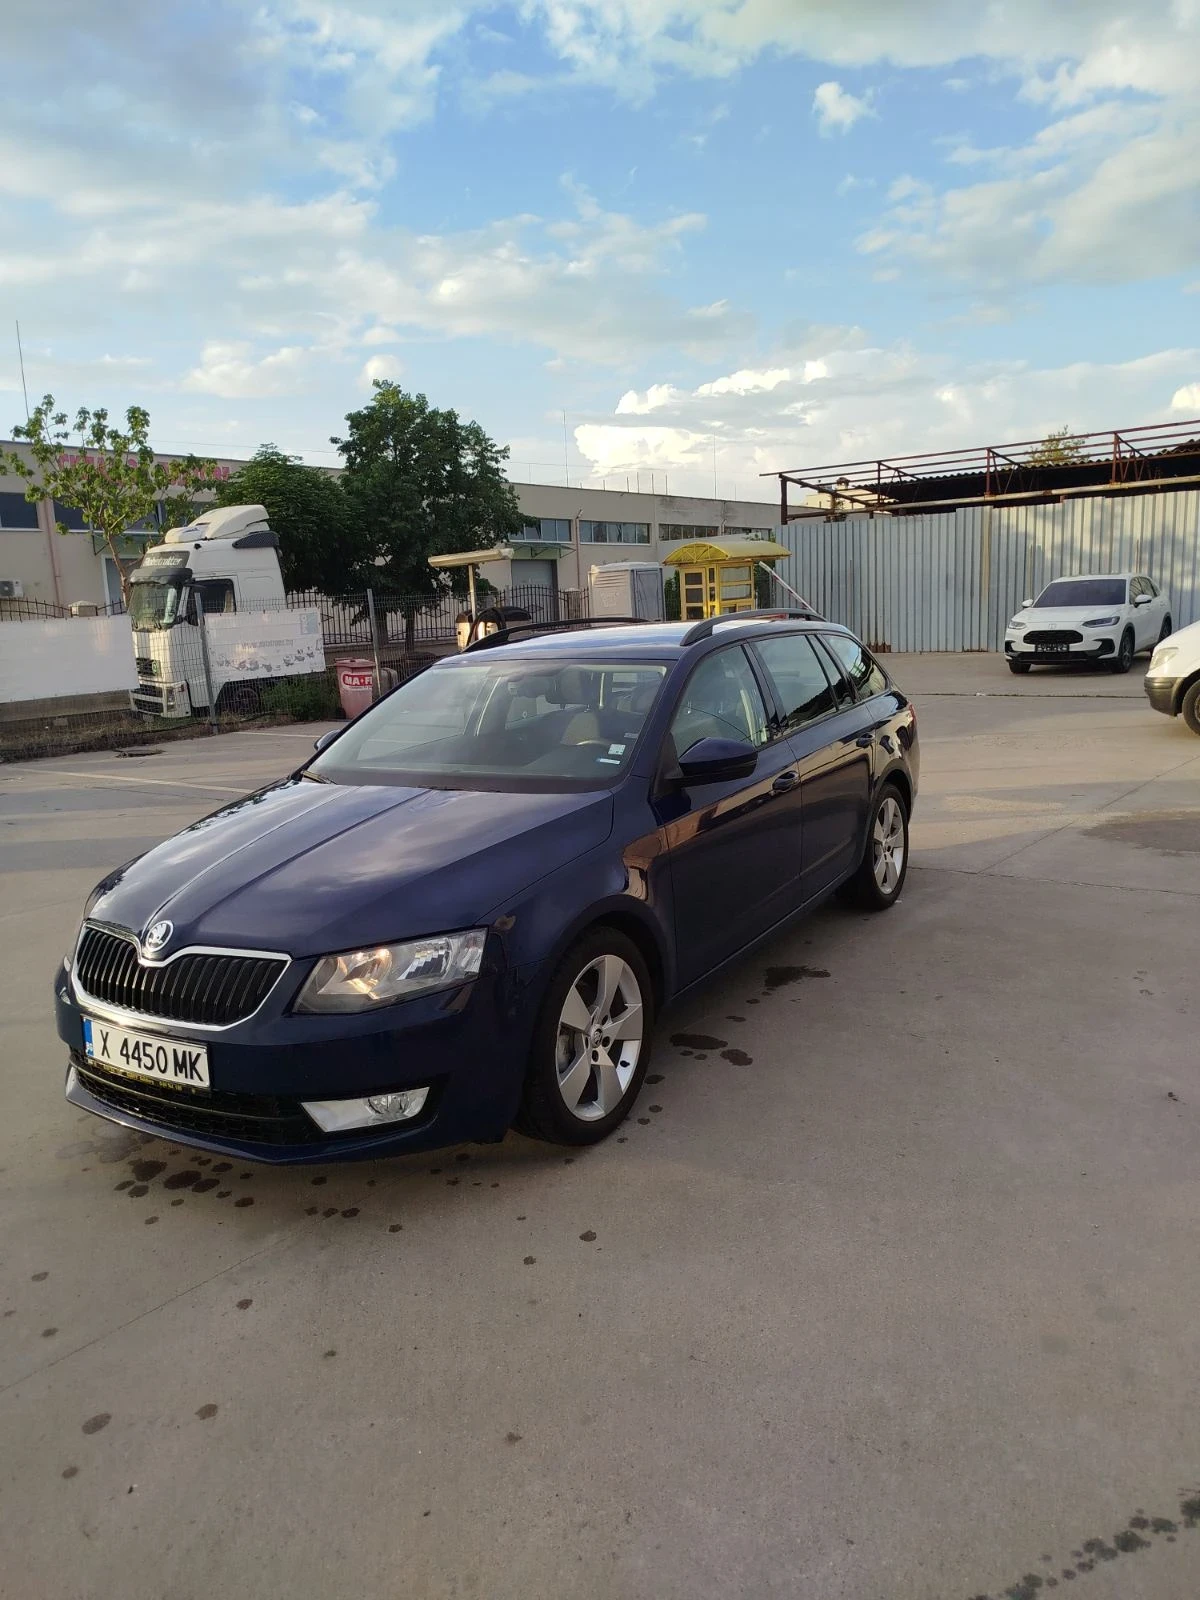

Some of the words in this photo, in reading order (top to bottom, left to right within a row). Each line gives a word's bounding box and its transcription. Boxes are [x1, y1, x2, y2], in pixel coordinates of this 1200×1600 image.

[100, 1029, 111, 1059] X
[120, 1037, 168, 1074] 4450
[172, 1048, 205, 1082] MK
